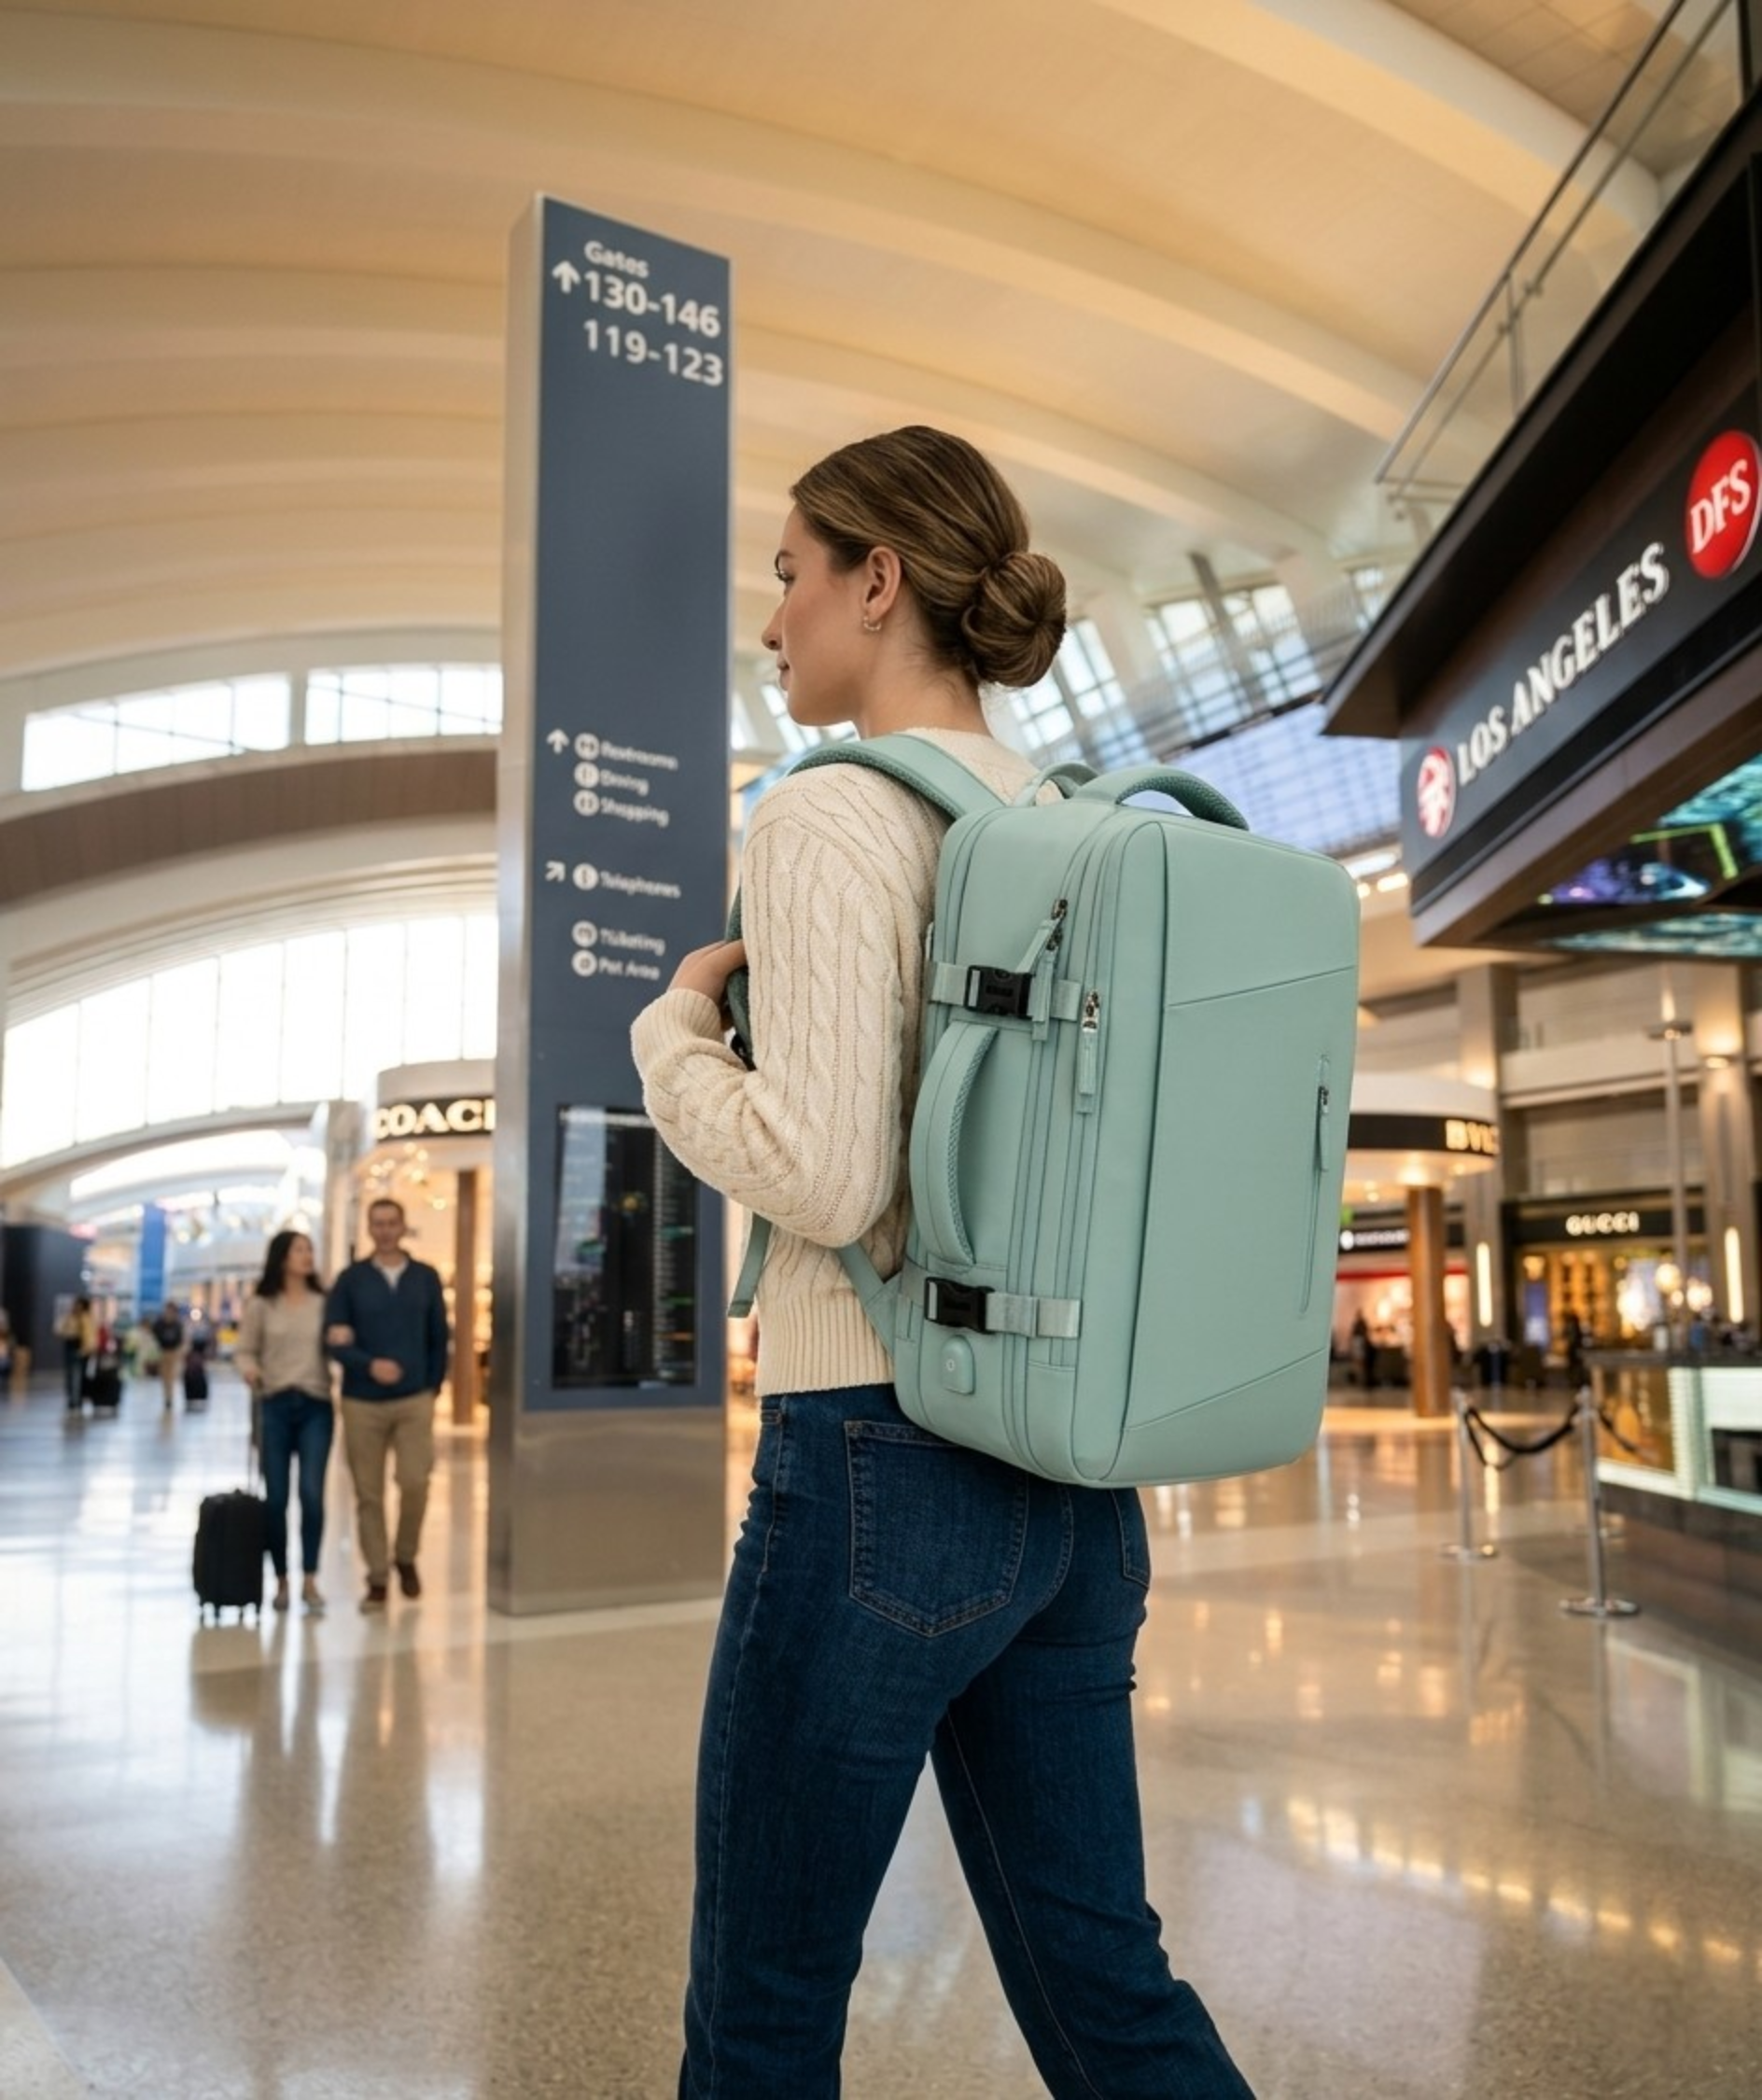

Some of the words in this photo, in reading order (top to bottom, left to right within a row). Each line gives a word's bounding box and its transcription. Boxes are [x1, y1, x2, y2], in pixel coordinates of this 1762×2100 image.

[584, 240, 649, 278] Gates
[584, 271, 720, 338] 130-146
[584, 319, 722, 386] 119-123
[1690, 459, 1751, 554] DFS
[1456, 705, 1508, 786] LOS
[1510, 542, 1669, 736] ANGELES
[1565, 1211, 1640, 1237] GUCCI
